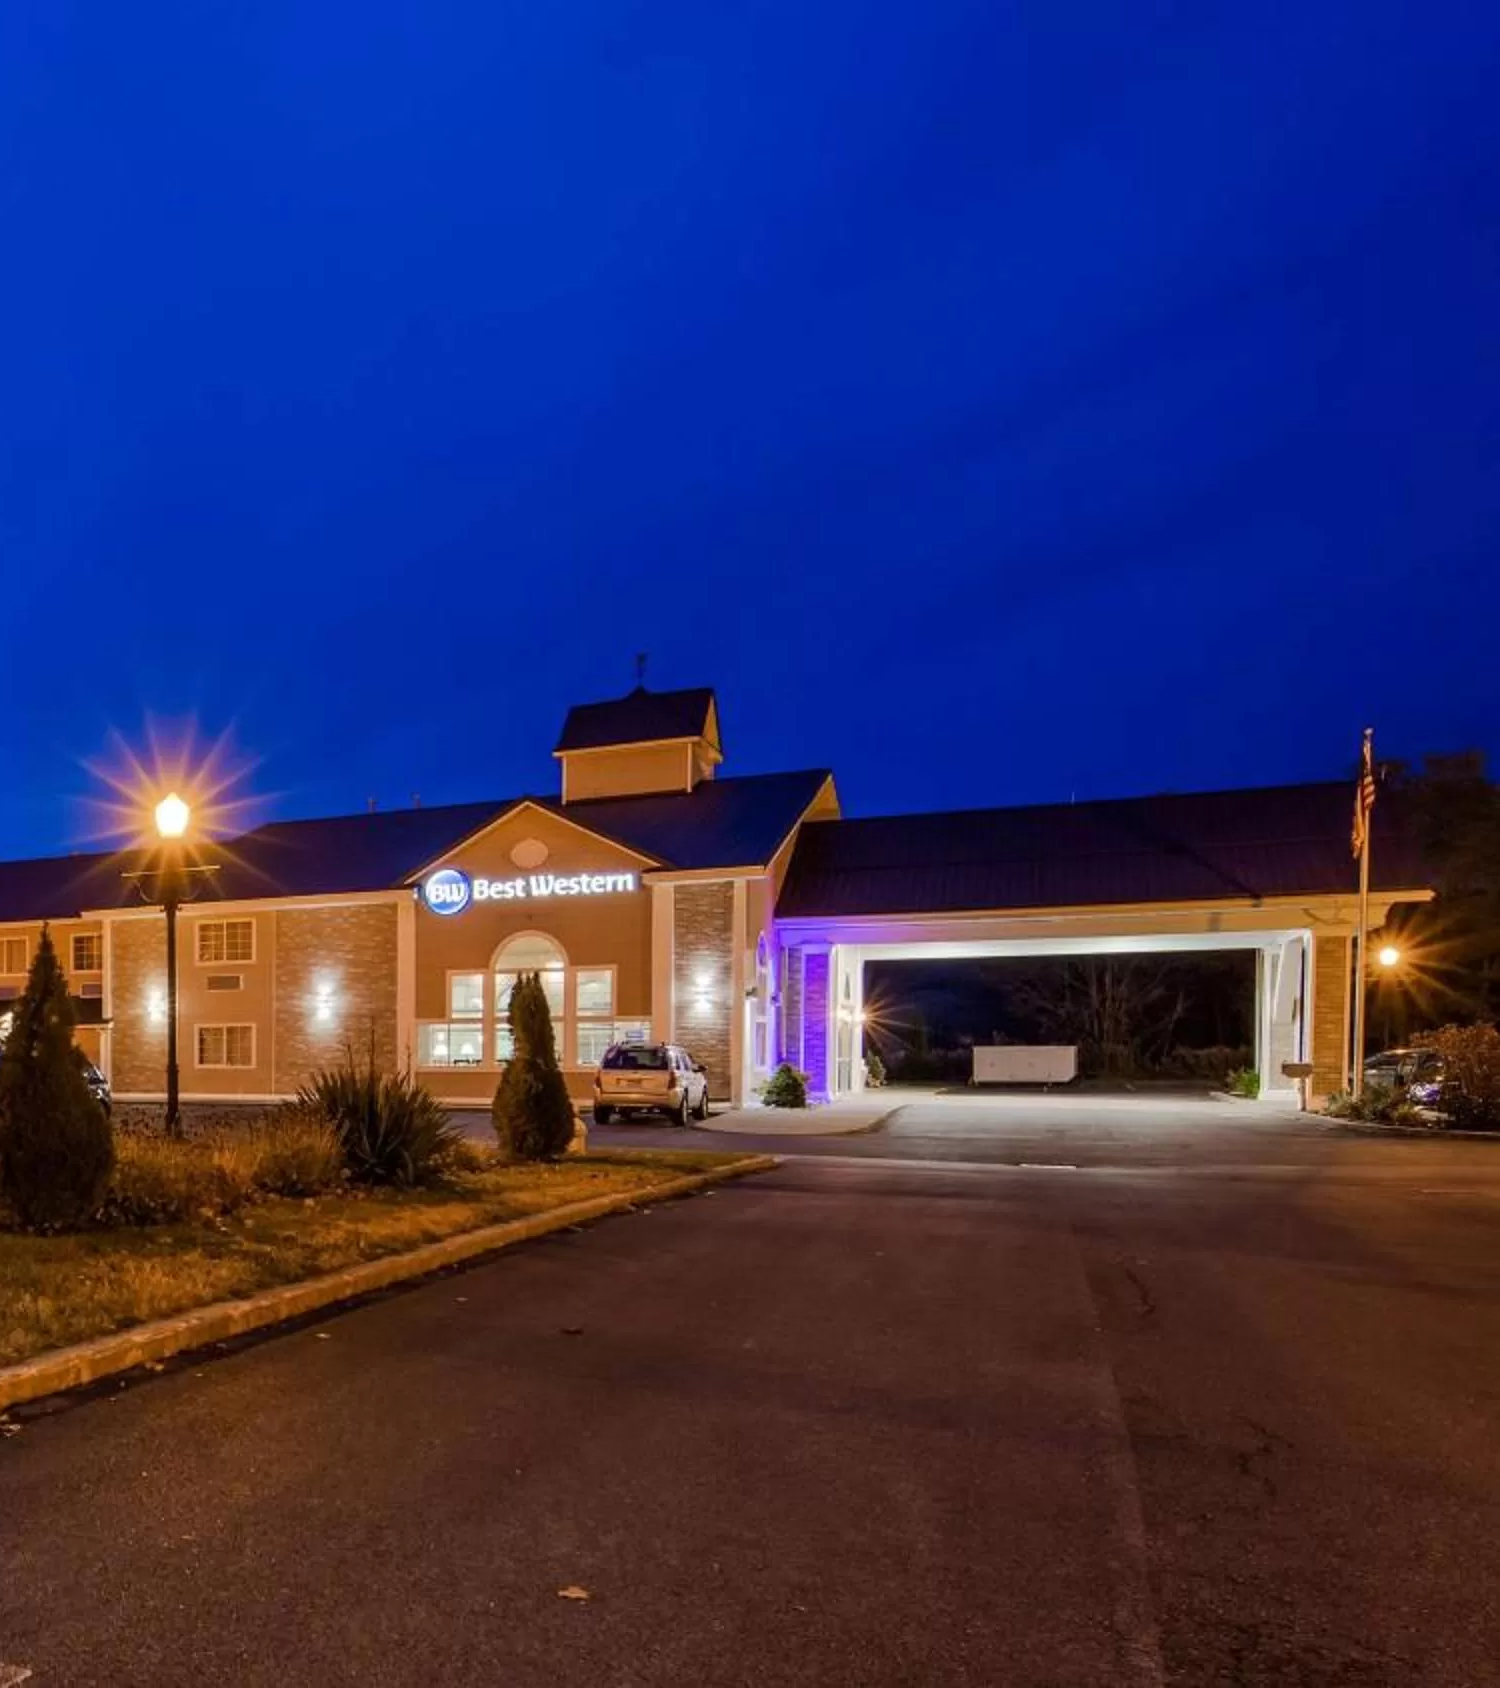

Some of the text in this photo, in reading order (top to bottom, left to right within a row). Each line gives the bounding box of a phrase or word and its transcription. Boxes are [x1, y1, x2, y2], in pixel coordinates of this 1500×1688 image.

[428, 873, 633, 904] BW Best Western
